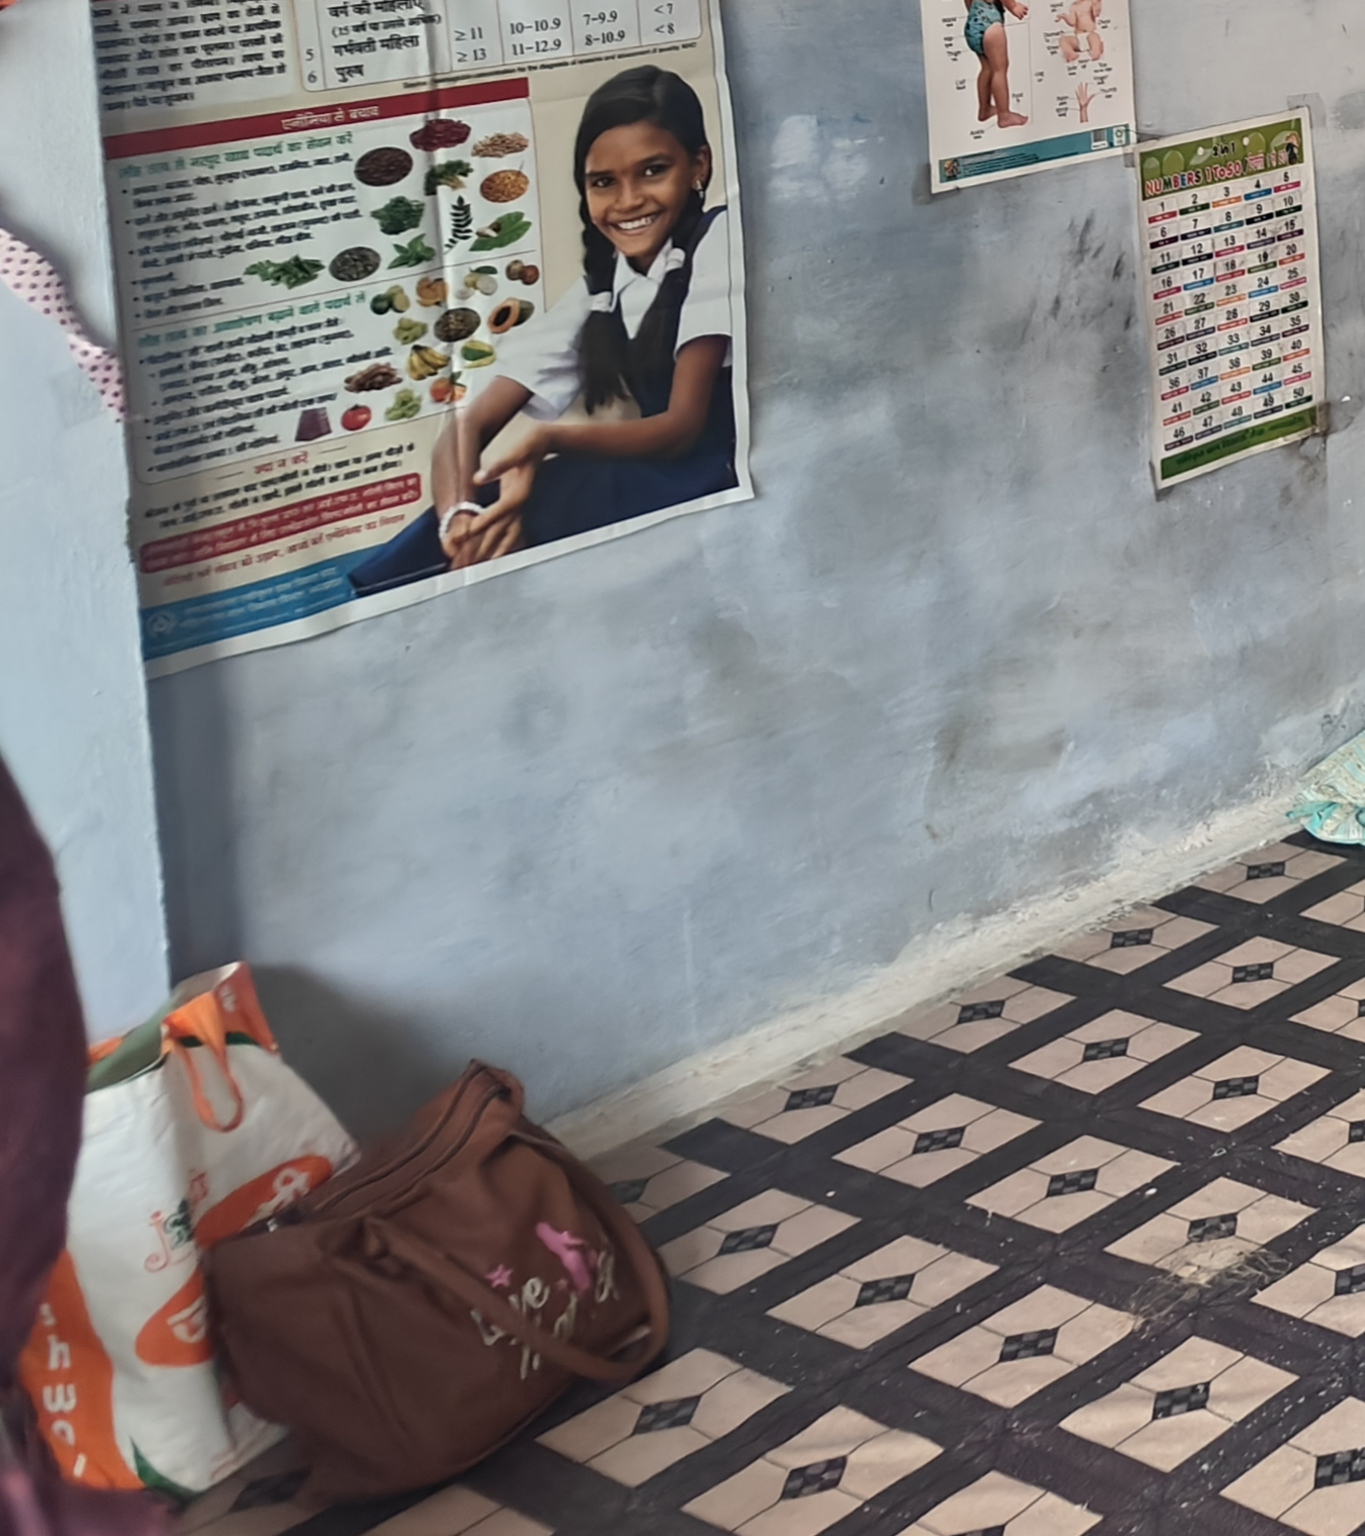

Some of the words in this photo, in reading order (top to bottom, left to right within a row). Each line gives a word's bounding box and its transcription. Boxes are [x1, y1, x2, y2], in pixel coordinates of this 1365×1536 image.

[306, 48, 314, 62] 5
[379, 33, 420, 50] महिला
[470, 27, 484, 40] 11
[308, 70, 317, 84] 6
[472, 48, 487, 61] 13
[1145, 170, 1202, 198] NUMBERS
[1160, 201, 1165, 211] 1
[1191, 194, 1198, 204] 2
[1223, 186, 1230, 197] 3
[1254, 179, 1261, 189] 4
[1283, 171, 1290, 182] 5
[1160, 226, 1167, 237] 6
[1192, 219, 1198, 229] 7
[1256, 203, 1263, 214] 9
[1283, 195, 1294, 207] 10
[1160, 252, 1171, 263] 11
[1191, 243, 1203, 254] 12
[1223, 235, 1236, 247] 13
[1255, 227, 1267, 239] 14
[1284, 219, 1295, 231] 15
